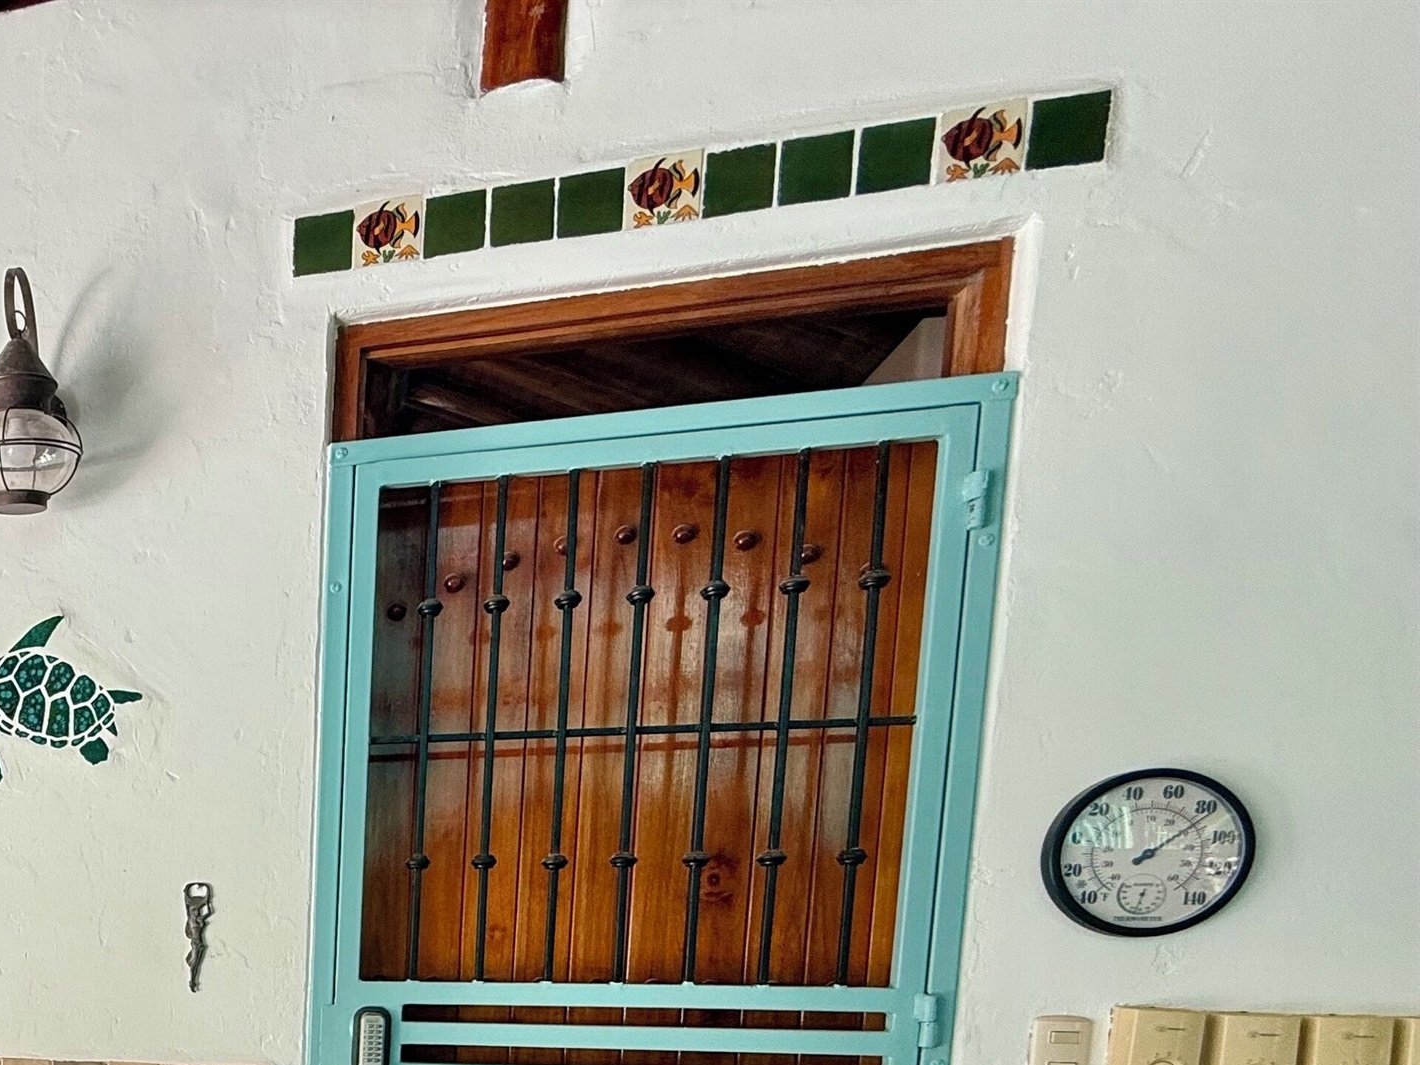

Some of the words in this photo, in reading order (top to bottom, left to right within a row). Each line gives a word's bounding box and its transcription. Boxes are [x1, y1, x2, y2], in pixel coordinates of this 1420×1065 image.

[1123, 786, 1144, 800] 40
[1163, 785, 1185, 799] 60
[1088, 802, 1110, 816] 20
[1194, 800, 1217, 814] 80
[1063, 863, 1082, 877] 20
[1182, 891, 1207, 905] 140
